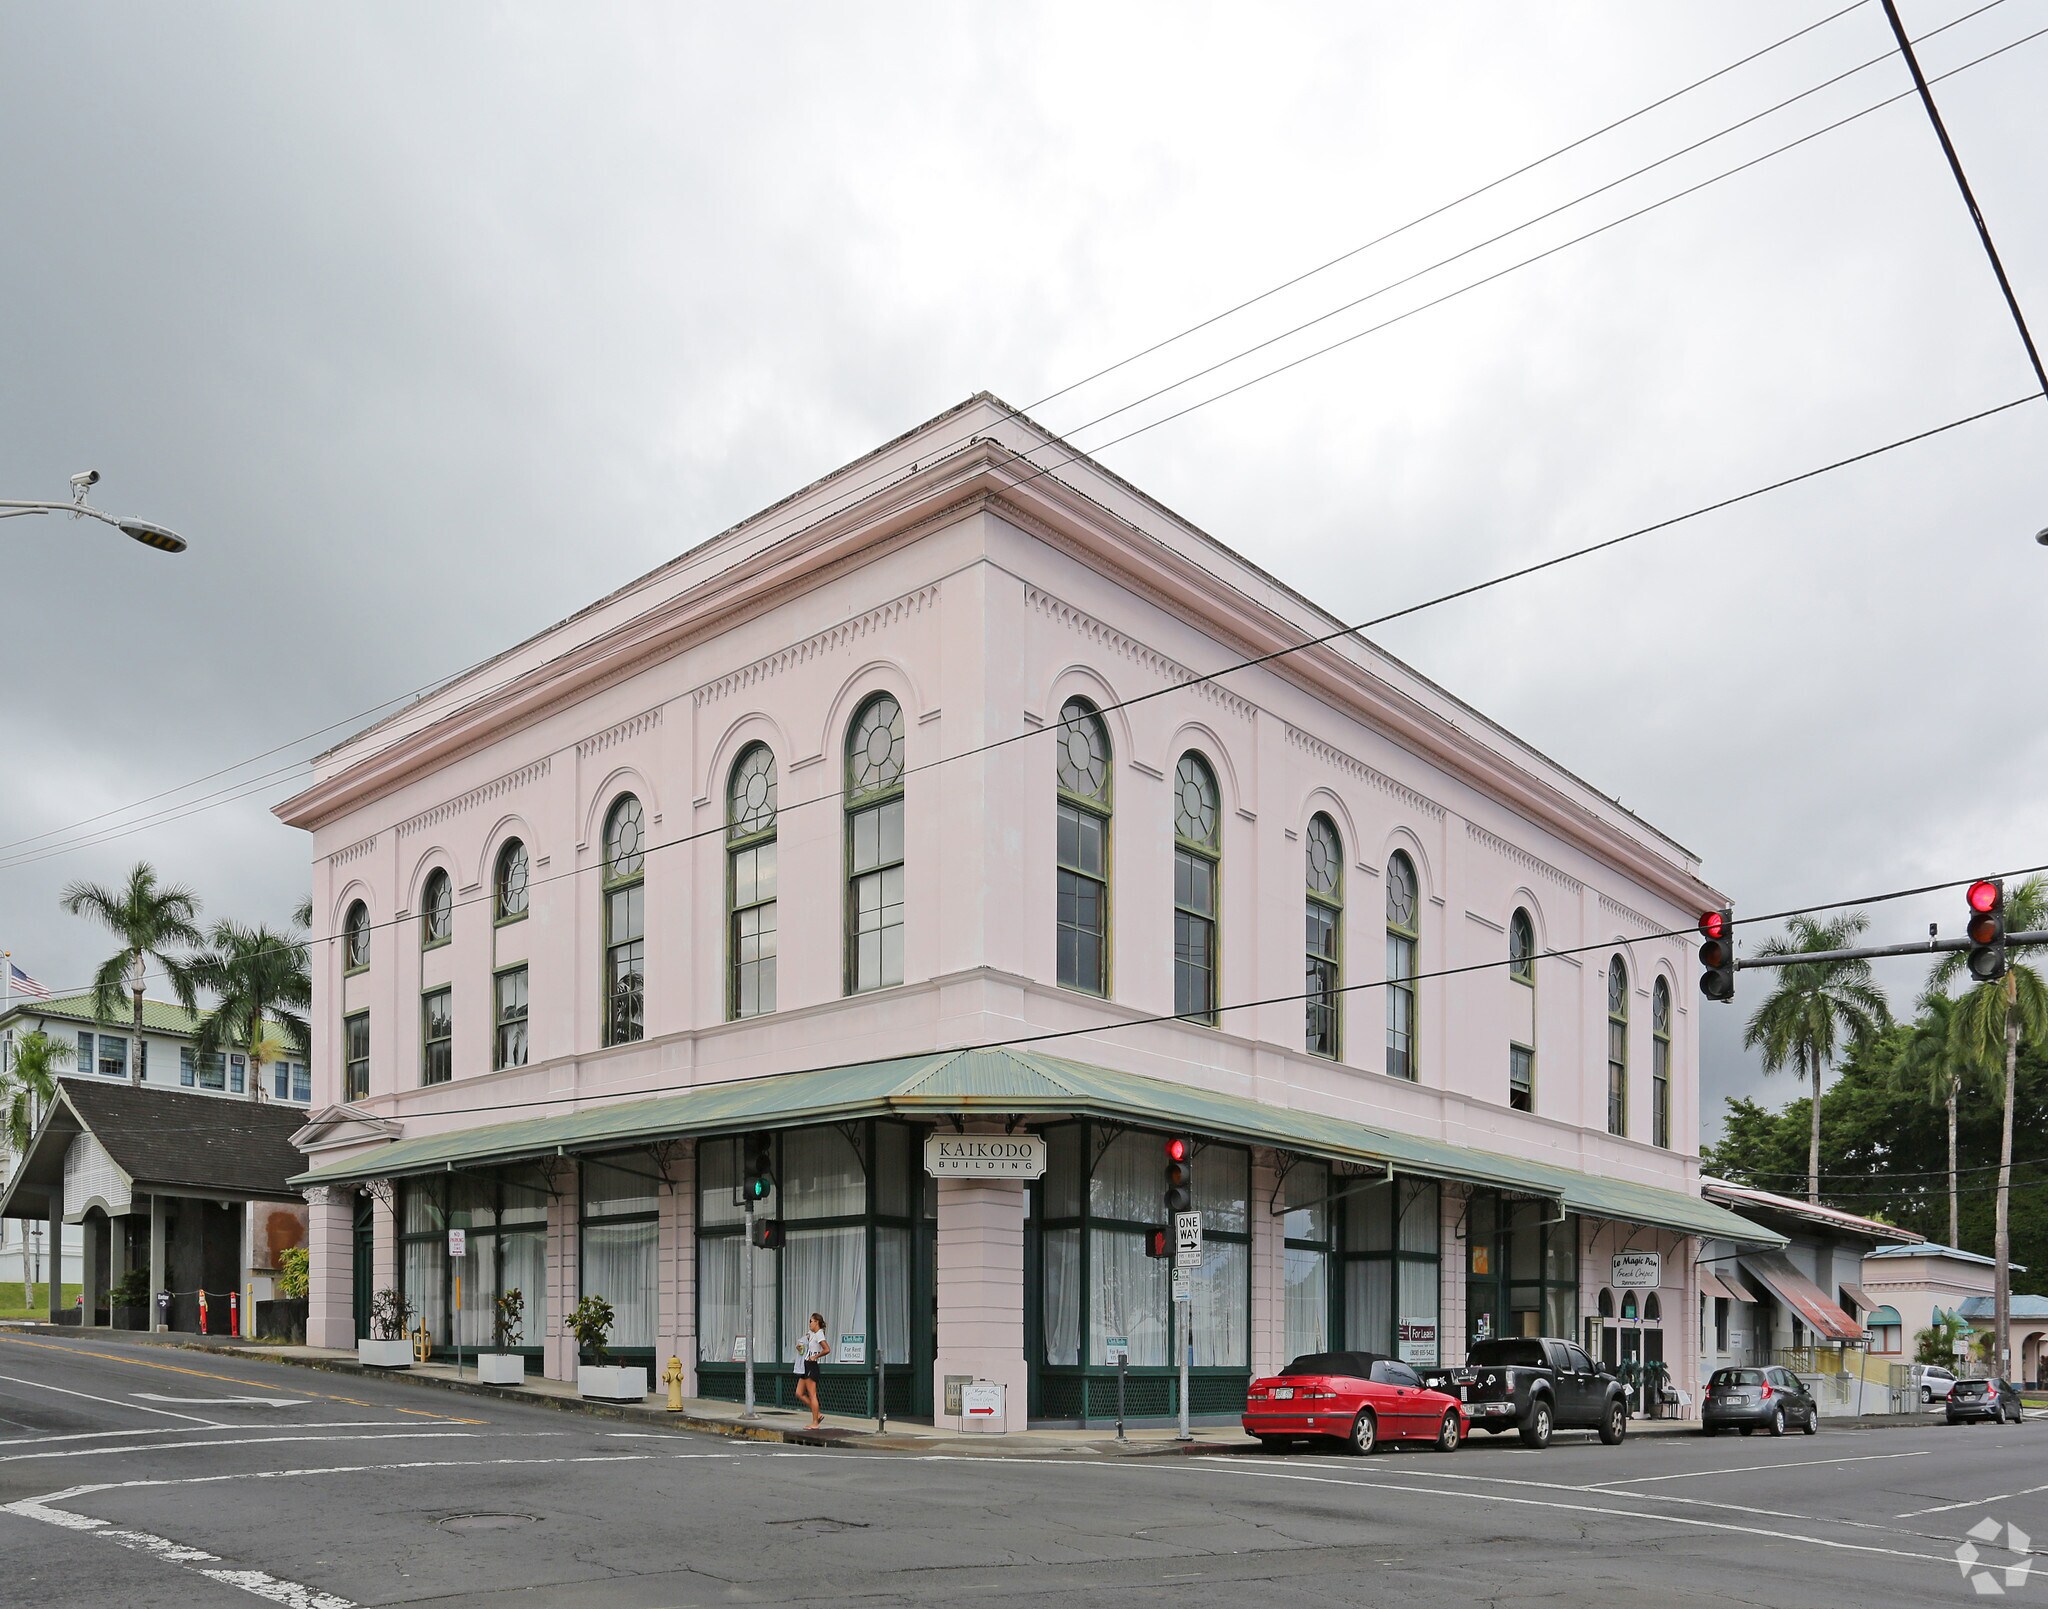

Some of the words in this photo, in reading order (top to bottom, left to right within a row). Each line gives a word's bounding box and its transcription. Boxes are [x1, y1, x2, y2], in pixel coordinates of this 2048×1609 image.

[940, 1143, 1032, 1158] KAIKODO
[939, 1161, 1032, 1170] BUILDING
[1179, 1217, 1198, 1228] ONE
[1180, 1228, 1199, 1240] WAY
[1613, 1260, 1620, 1268] Le
[1622, 1256, 1644, 1266] Magic
[1645, 1257, 1657, 1267] Pan
[1173, 1270, 1178, 1280] 2
[1616, 1268, 1633, 1278] French
[1412, 1328, 1421, 1339] For
[1421, 1328, 1434, 1339] Lease
